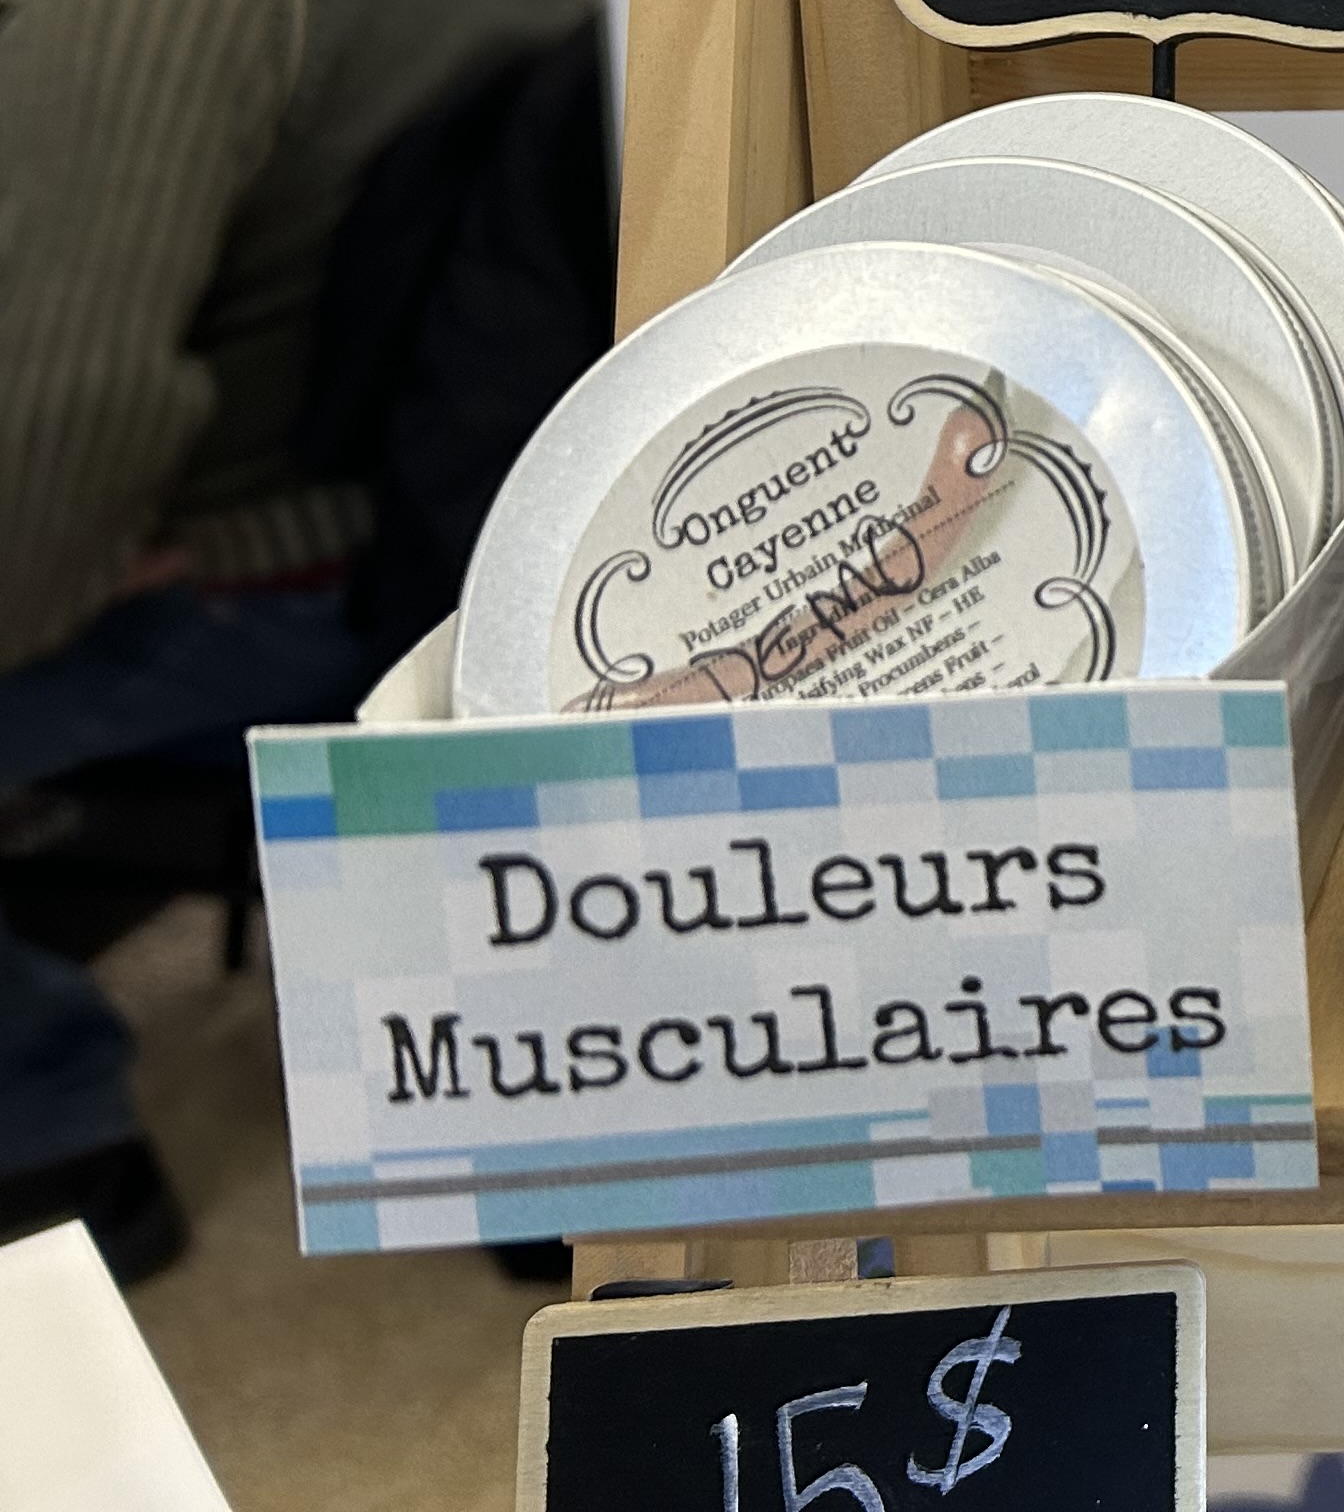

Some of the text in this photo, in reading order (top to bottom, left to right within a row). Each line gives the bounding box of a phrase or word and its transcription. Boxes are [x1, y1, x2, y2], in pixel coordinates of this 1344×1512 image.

[682, 433, 858, 546] Onguent
[707, 479, 880, 589] Cayenne
[682, 598, 762, 652] Potager
[762, 552, 838, 602] Urbain
[962, 550, 1001, 581] Alba
[865, 637, 906, 664] Wax
[905, 615, 935, 646] NF
[954, 586, 986, 613] HE
[481, 838, 1106, 948] Douleurs
[382, 976, 1227, 1105] Musculaires
